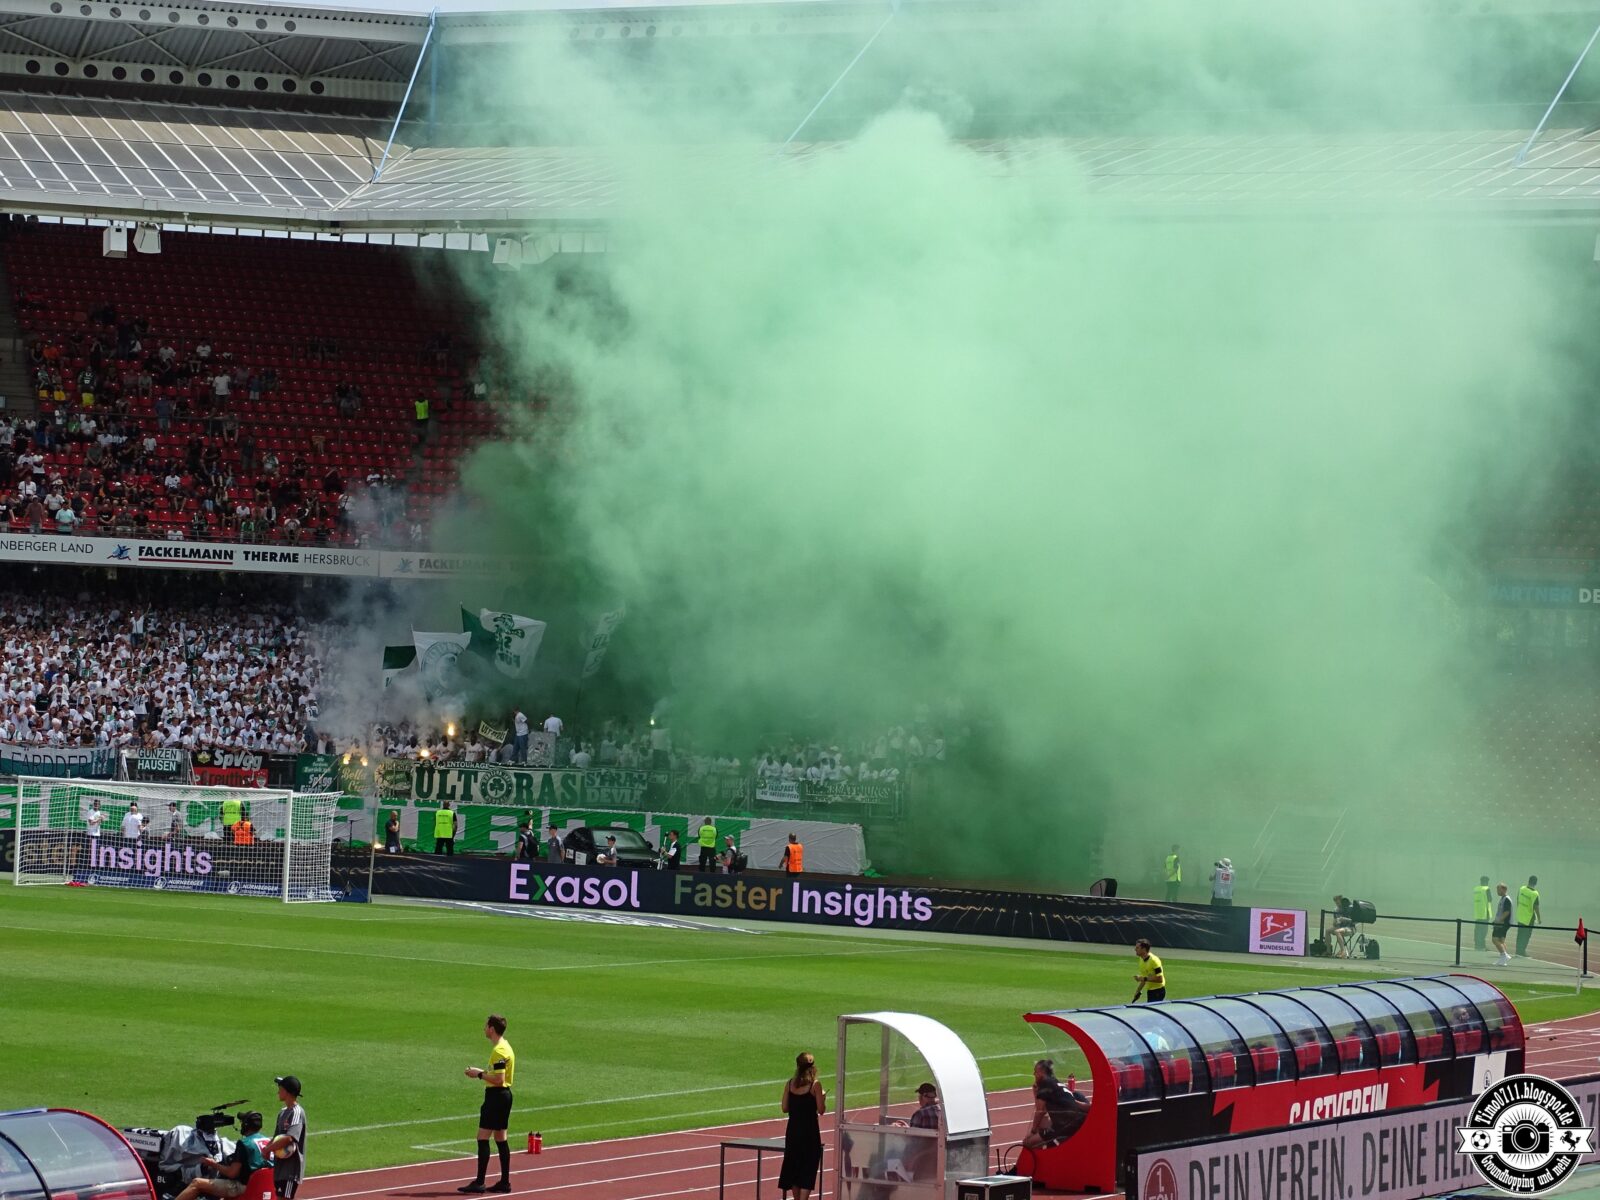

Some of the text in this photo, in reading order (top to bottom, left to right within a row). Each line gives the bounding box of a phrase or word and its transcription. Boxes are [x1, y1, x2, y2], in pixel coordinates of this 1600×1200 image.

[0, 539, 94, 554] NBERGER LAND
[138, 545, 371, 567] FACKELMANN THERME HERSBRUCK
[137, 760, 176, 772] HAUSEN
[213, 749, 262, 771] SpVgg
[90, 838, 213, 877] Insights
[509, 863, 640, 907] Exasol
[674, 875, 933, 926] Faster Insights
[1282, 928, 1293, 942] 2
[1259, 943, 1295, 952] BUNDESLIGA
[1188, 1151, 1250, 1200] DEIN
[1257, 1135, 1354, 1200] VEREIN.
[1361, 1122, 1428, 1197] DEINE
